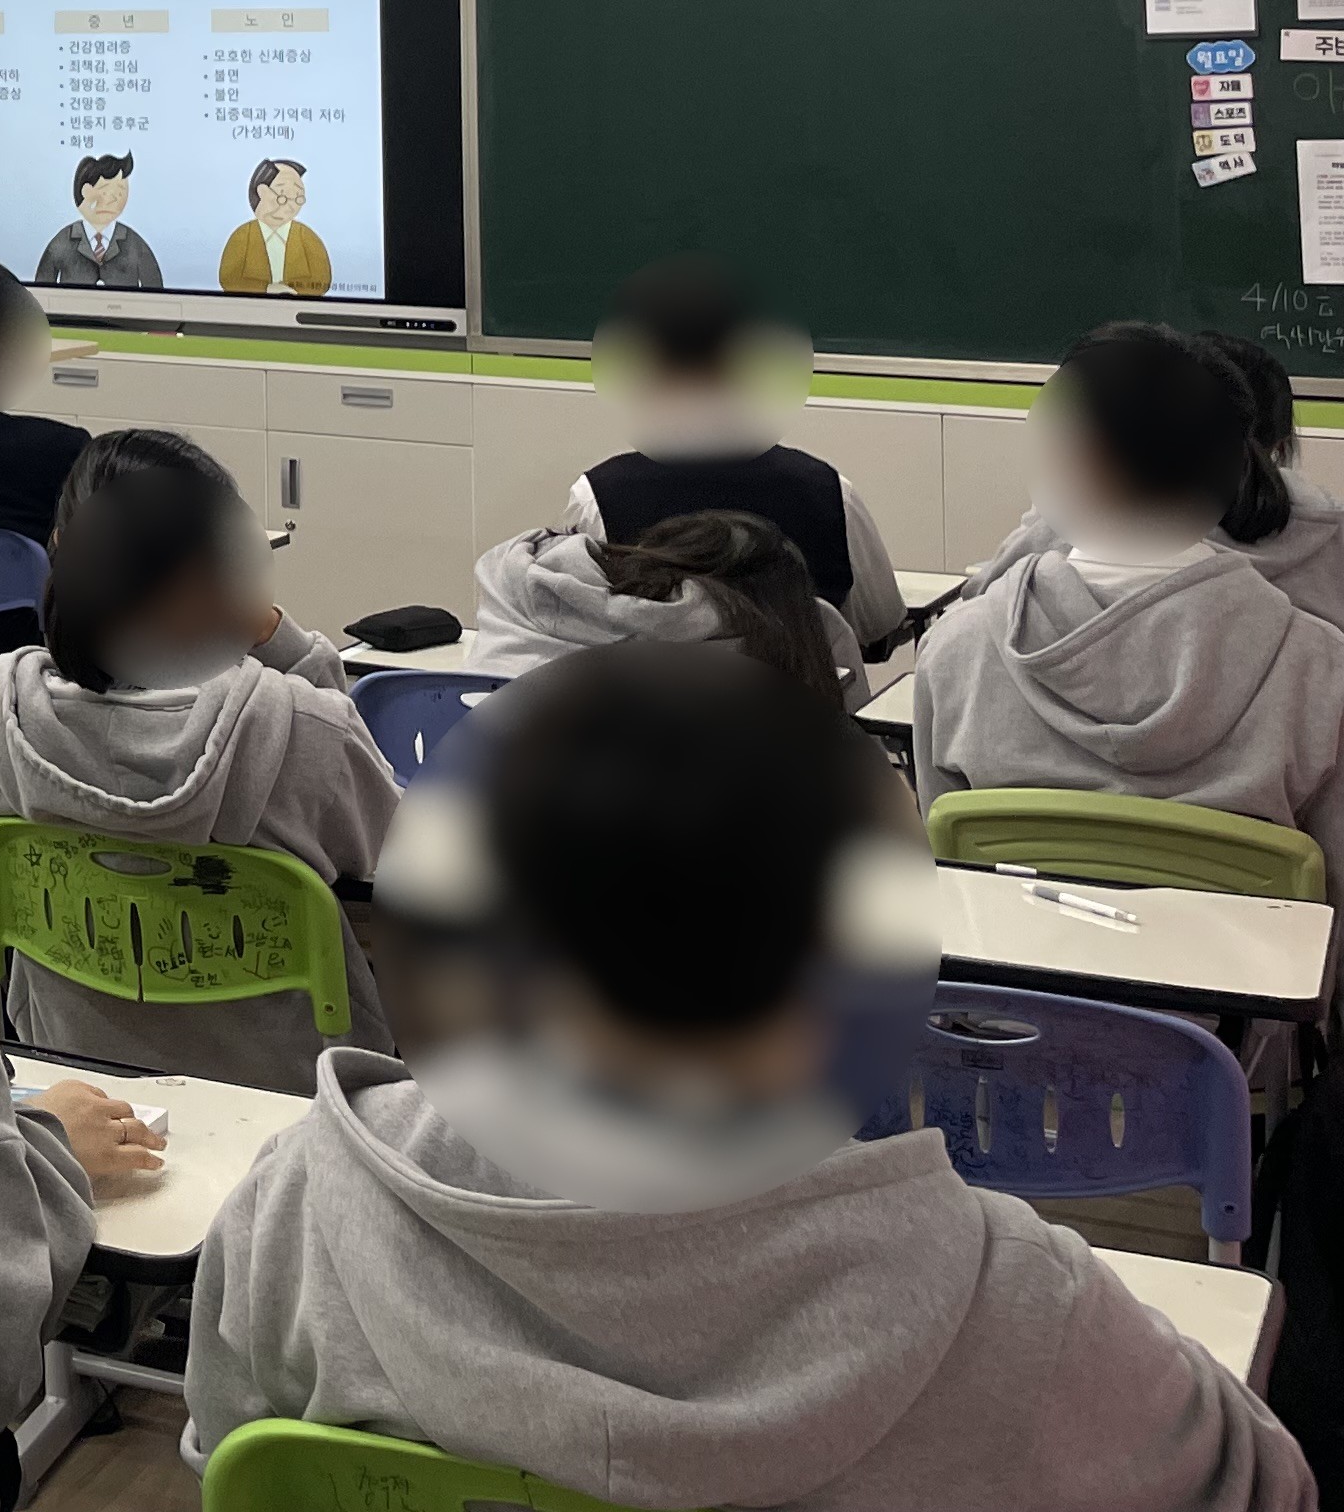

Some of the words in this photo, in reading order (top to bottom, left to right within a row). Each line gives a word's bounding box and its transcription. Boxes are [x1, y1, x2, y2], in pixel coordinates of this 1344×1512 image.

[68, 40, 131, 55] 건강염려증
[213, 48, 253, 64] 모호한
[258, 48, 312, 64] 신체증상
[1197, 48, 1244, 69] 월요일
[69, 59, 109, 75] 죄책감,
[113, 59, 139, 74] 의심
[214, 68, 240, 83] 불면
[69, 78, 109, 93] 절망감,
[113, 78, 152, 93] 공허감
[214, 87, 240, 102] 불안
[69, 96, 107, 111] 건망증
[214, 107, 267, 122] 집중력과
[272, 107, 313, 123] 기억력
[318, 107, 346, 123] 저하
[1214, 107, 1247, 120] 스포츠
[70, 115, 106, 131] 빈둥지
[111, 116, 150, 131] 증후군
[231, 125, 295, 141] (가성치매)
[1220, 133, 1245, 146] 도덕
[70, 134, 95, 149] 화병
